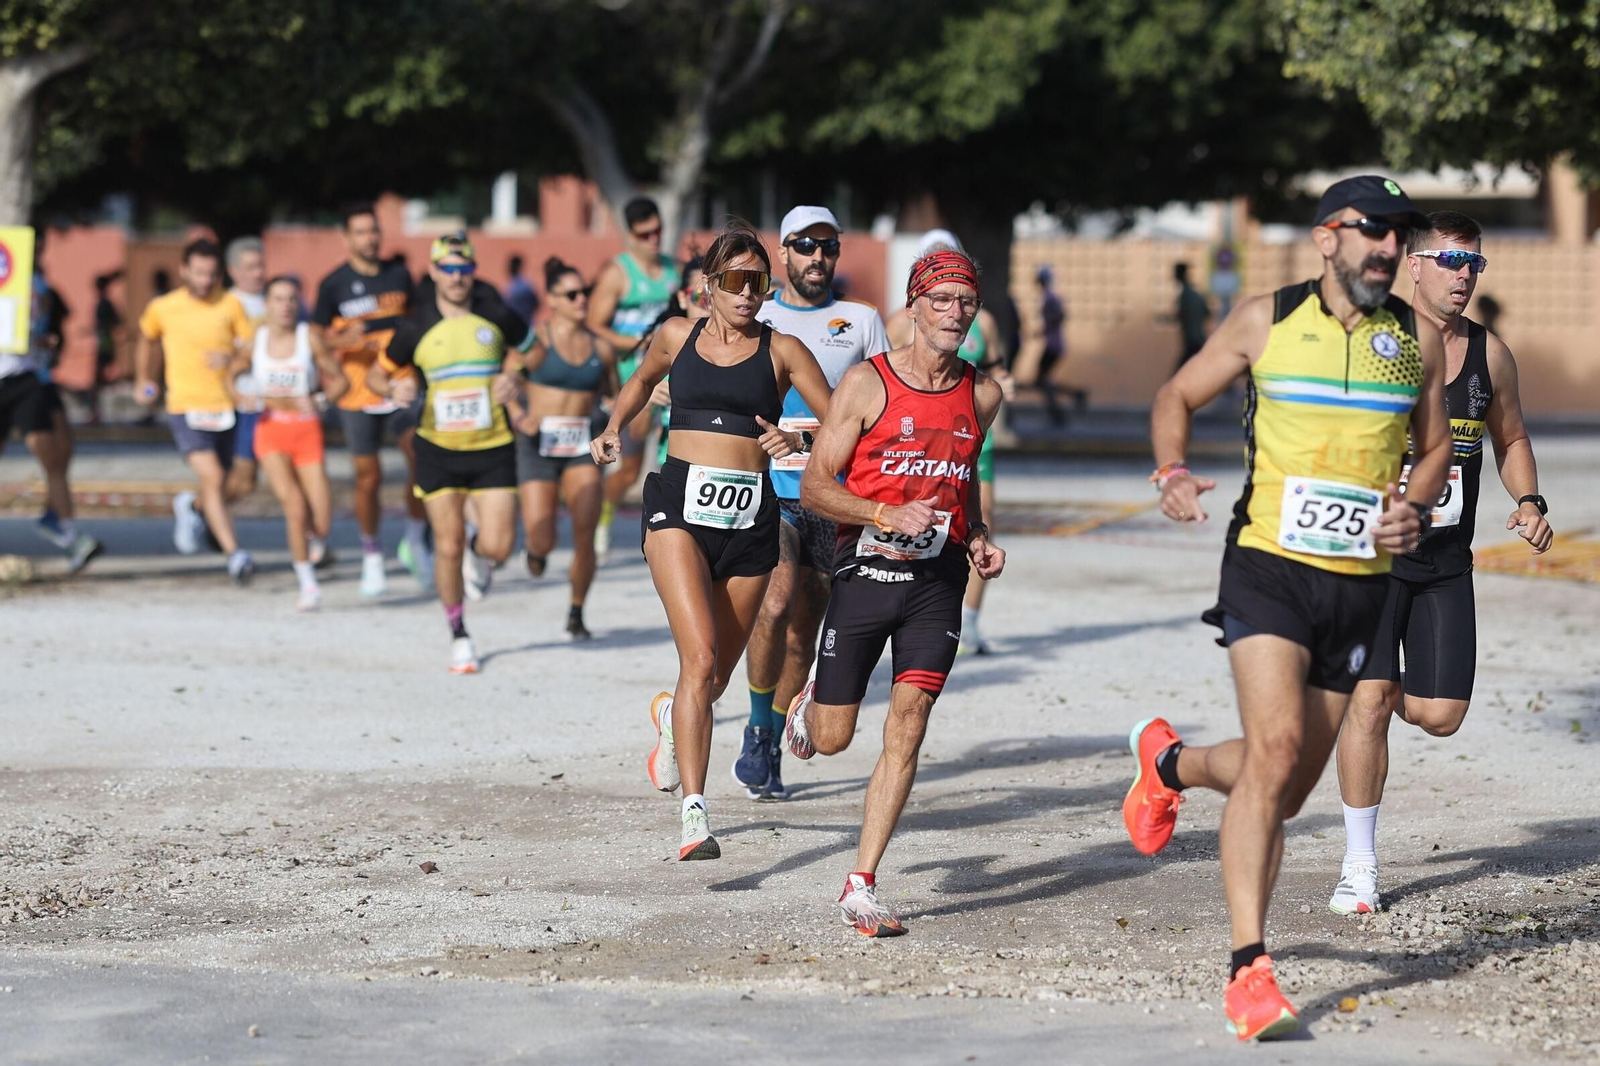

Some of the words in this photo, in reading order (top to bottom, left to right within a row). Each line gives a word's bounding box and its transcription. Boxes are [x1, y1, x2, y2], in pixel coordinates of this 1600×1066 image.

[883, 450, 925, 458] ATLETISMO
[697, 482, 753, 511] 900
[1297, 500, 1369, 536] 525
